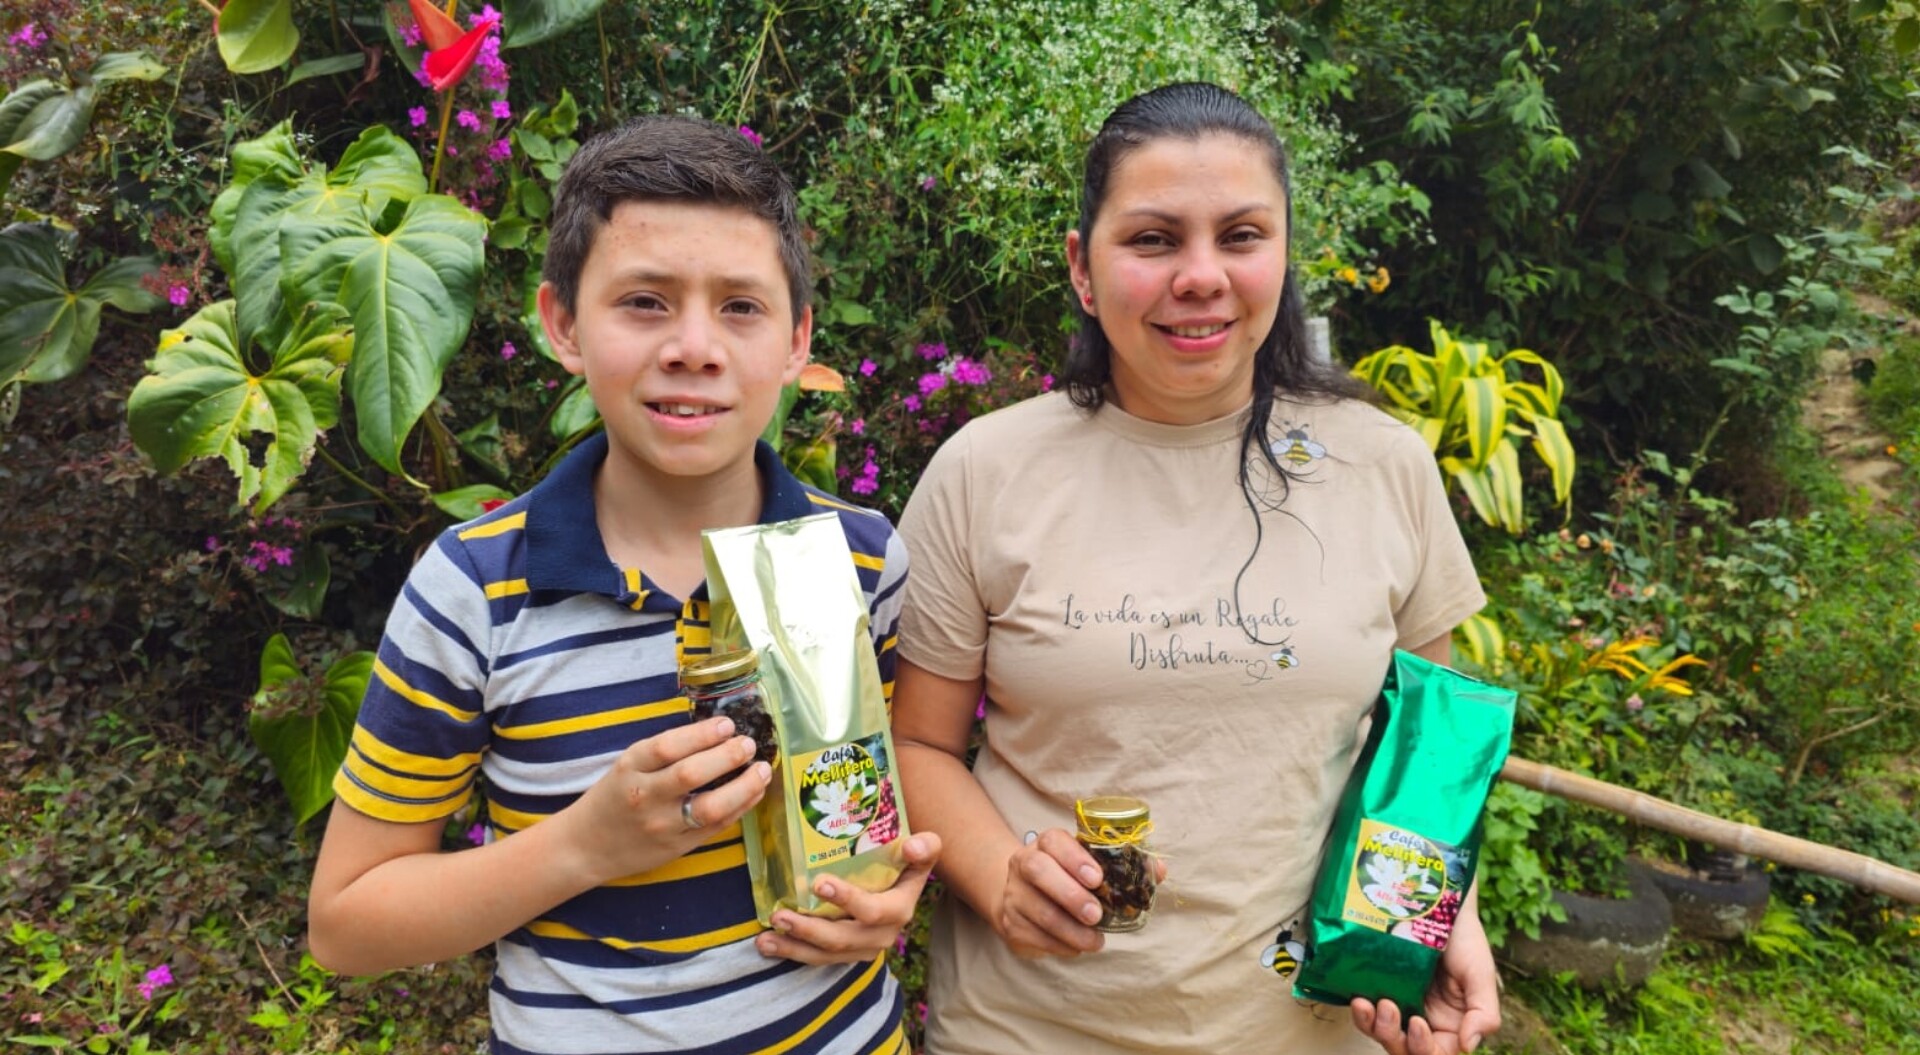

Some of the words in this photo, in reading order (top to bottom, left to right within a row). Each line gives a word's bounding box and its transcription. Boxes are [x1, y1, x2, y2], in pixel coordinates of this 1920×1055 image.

[1061, 593, 1088, 630] La
[1095, 593, 1144, 625] vida
[1150, 609, 1173, 629] es
[1179, 611, 1207, 626] un
